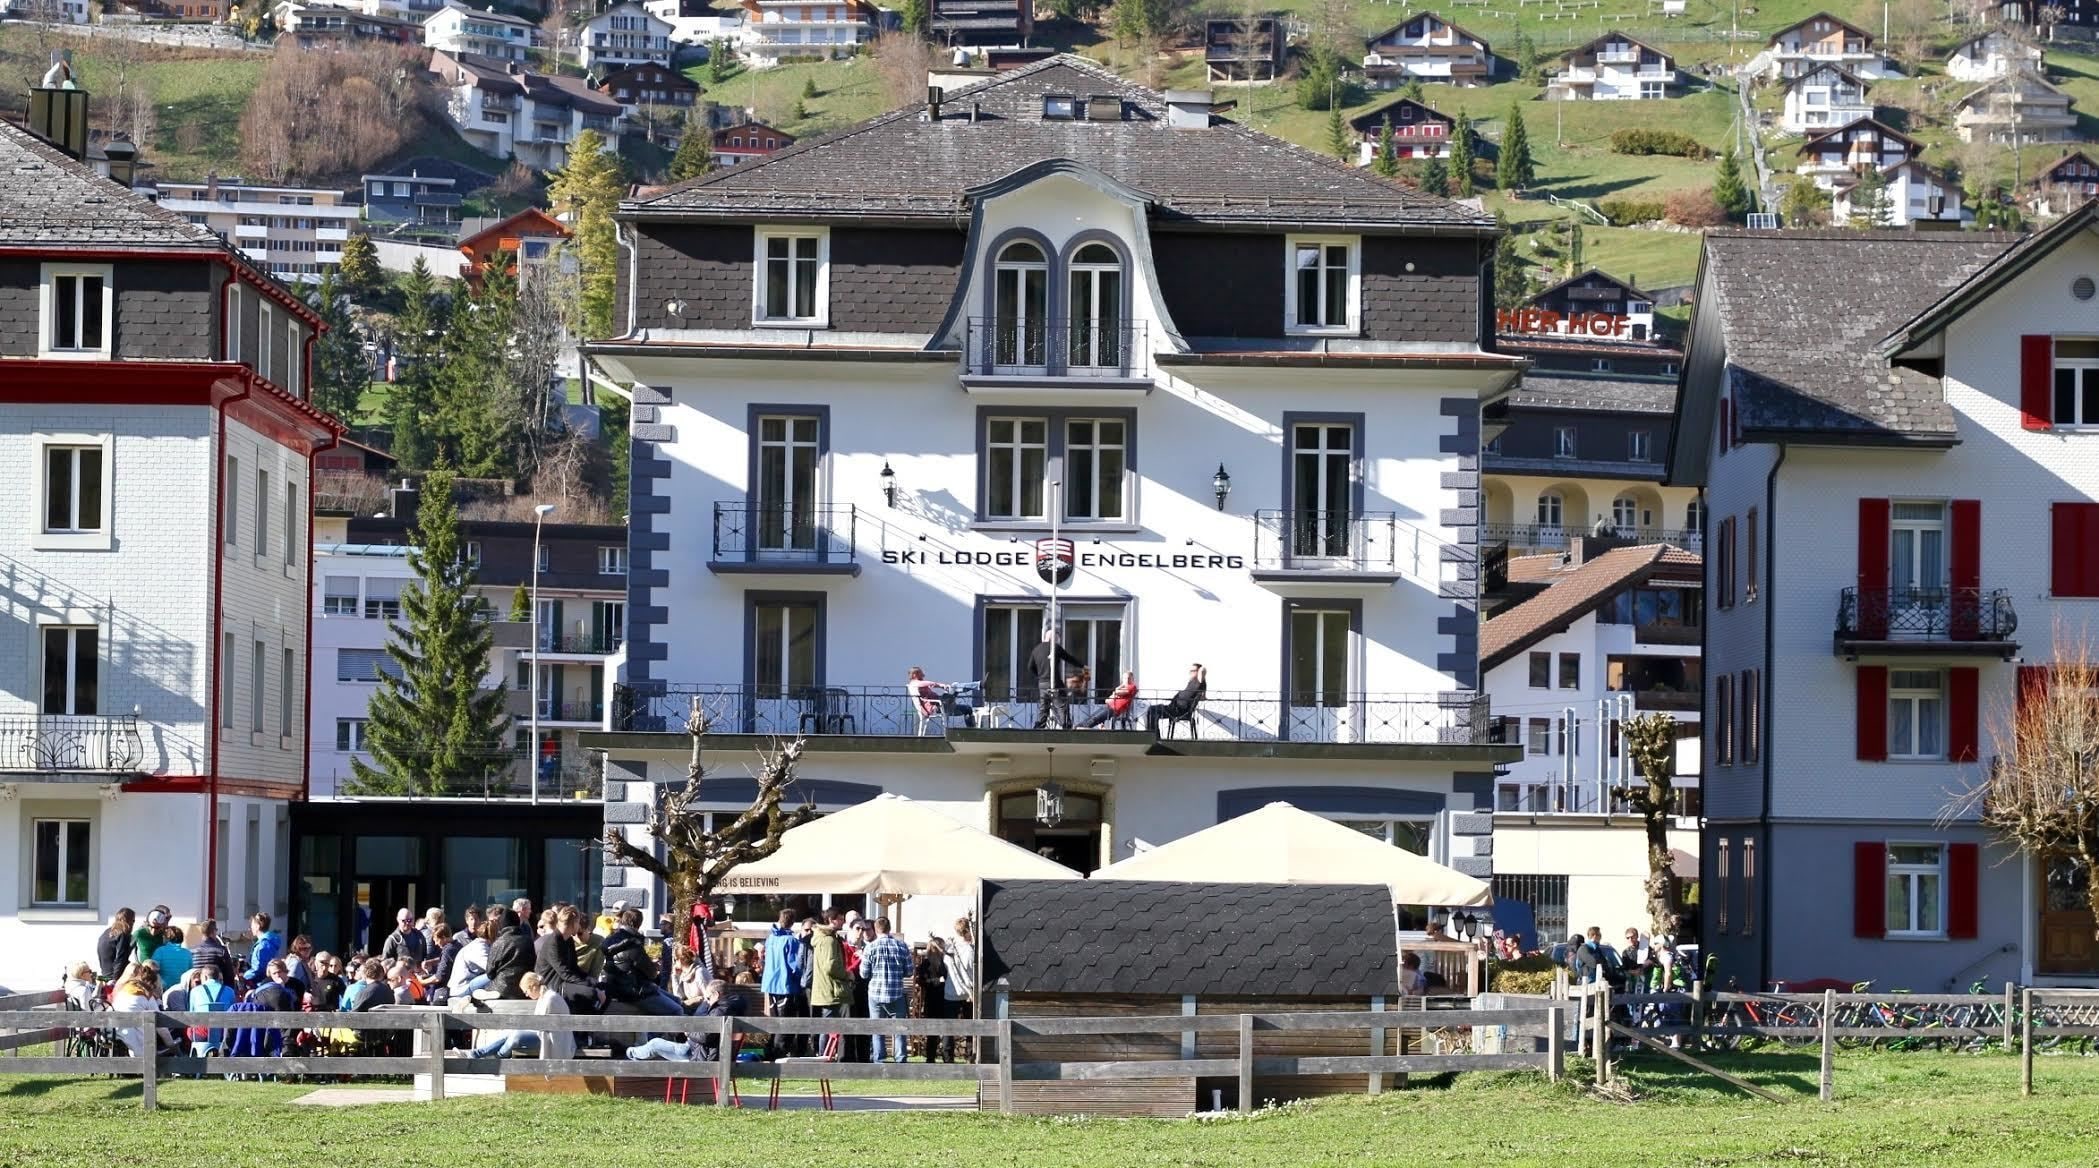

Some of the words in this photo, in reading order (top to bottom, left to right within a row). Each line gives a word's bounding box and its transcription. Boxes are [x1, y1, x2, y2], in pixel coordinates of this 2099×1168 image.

[1568, 311, 1631, 337] HOF
[882, 551, 926, 564] SKI
[939, 551, 1030, 566] LODGE
[1081, 553, 1244, 569] ENGELBERG
[730, 877, 738, 888] IS
[740, 877, 780, 888] BELIEVING
